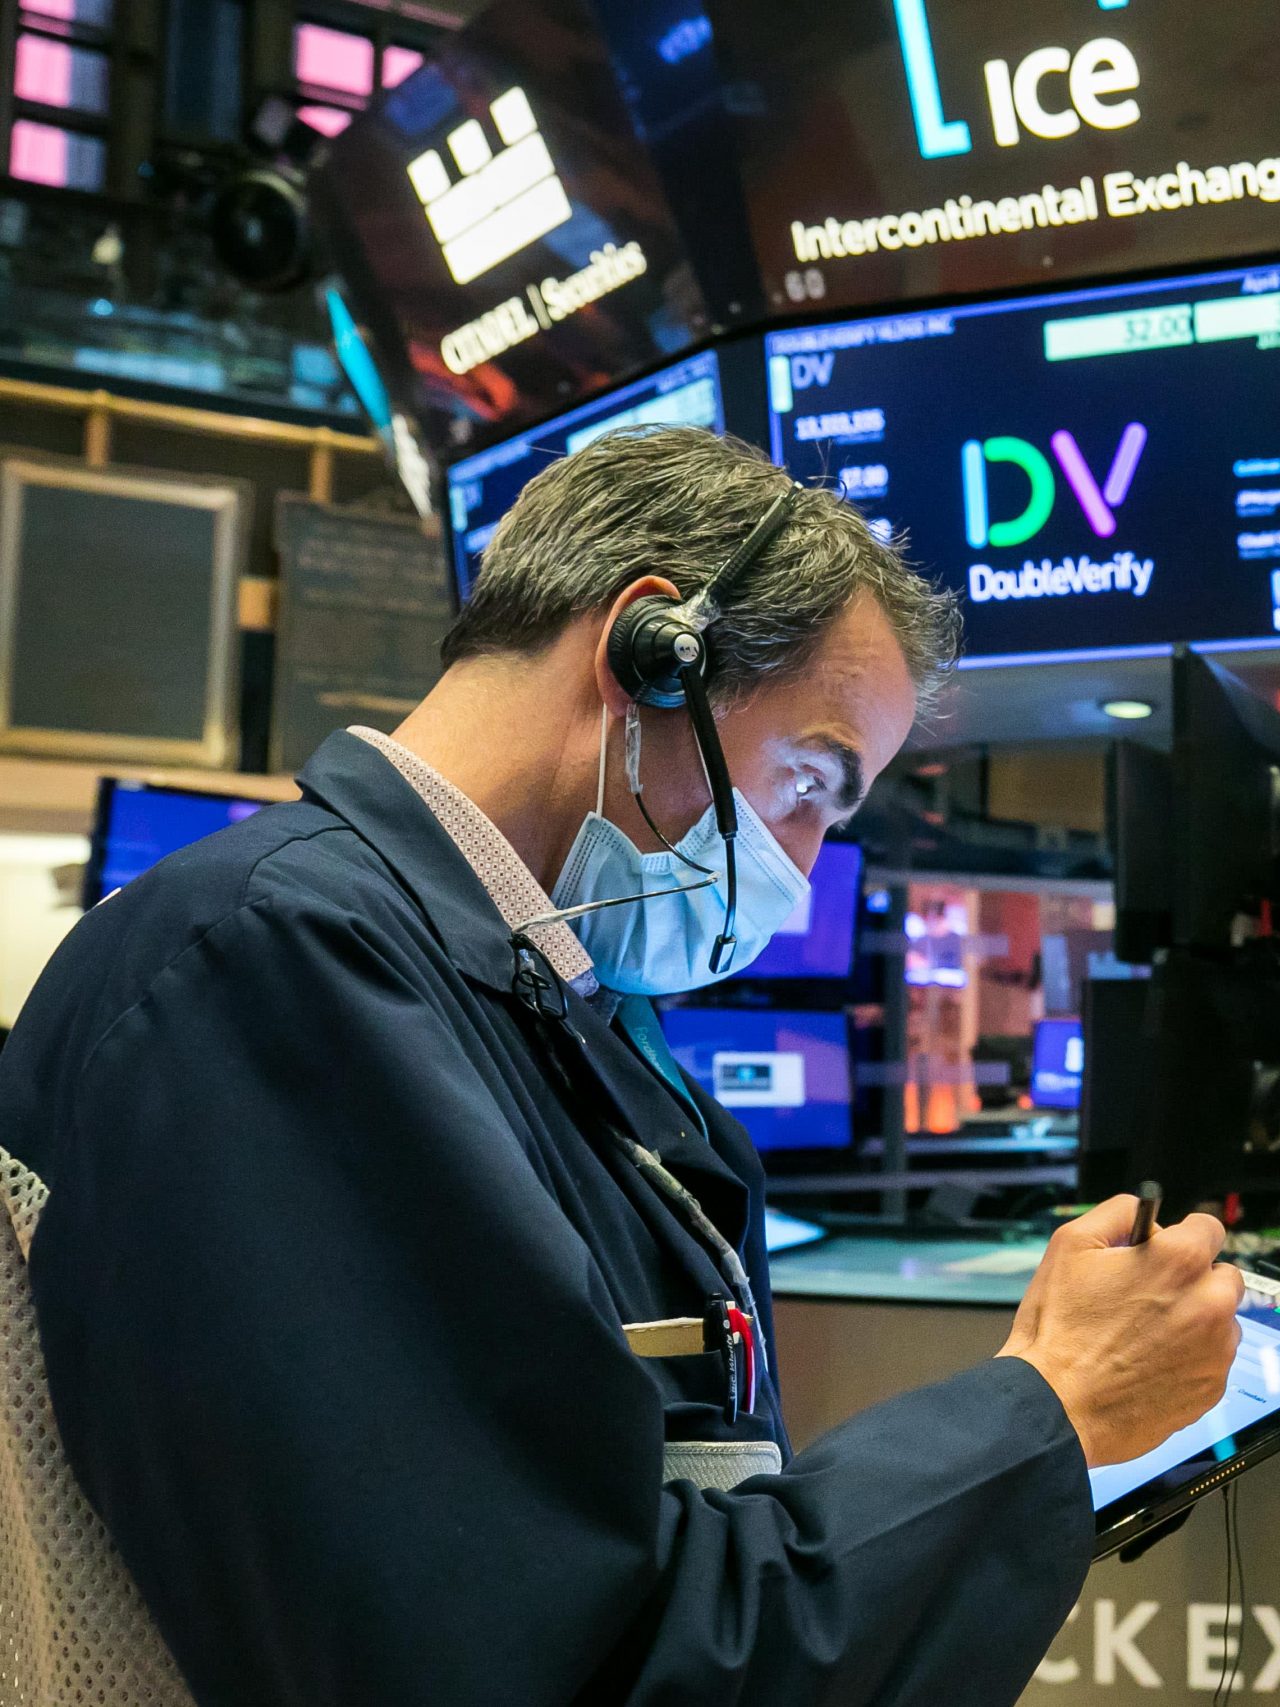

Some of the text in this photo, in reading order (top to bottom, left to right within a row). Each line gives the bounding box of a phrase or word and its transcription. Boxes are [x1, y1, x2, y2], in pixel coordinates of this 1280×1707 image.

[790, 176, 1098, 263] Intercontinental
[790, 350, 836, 391] DV
[960, 420, 1148, 550] DV
[967, 550, 1155, 604] DoubleVerify
